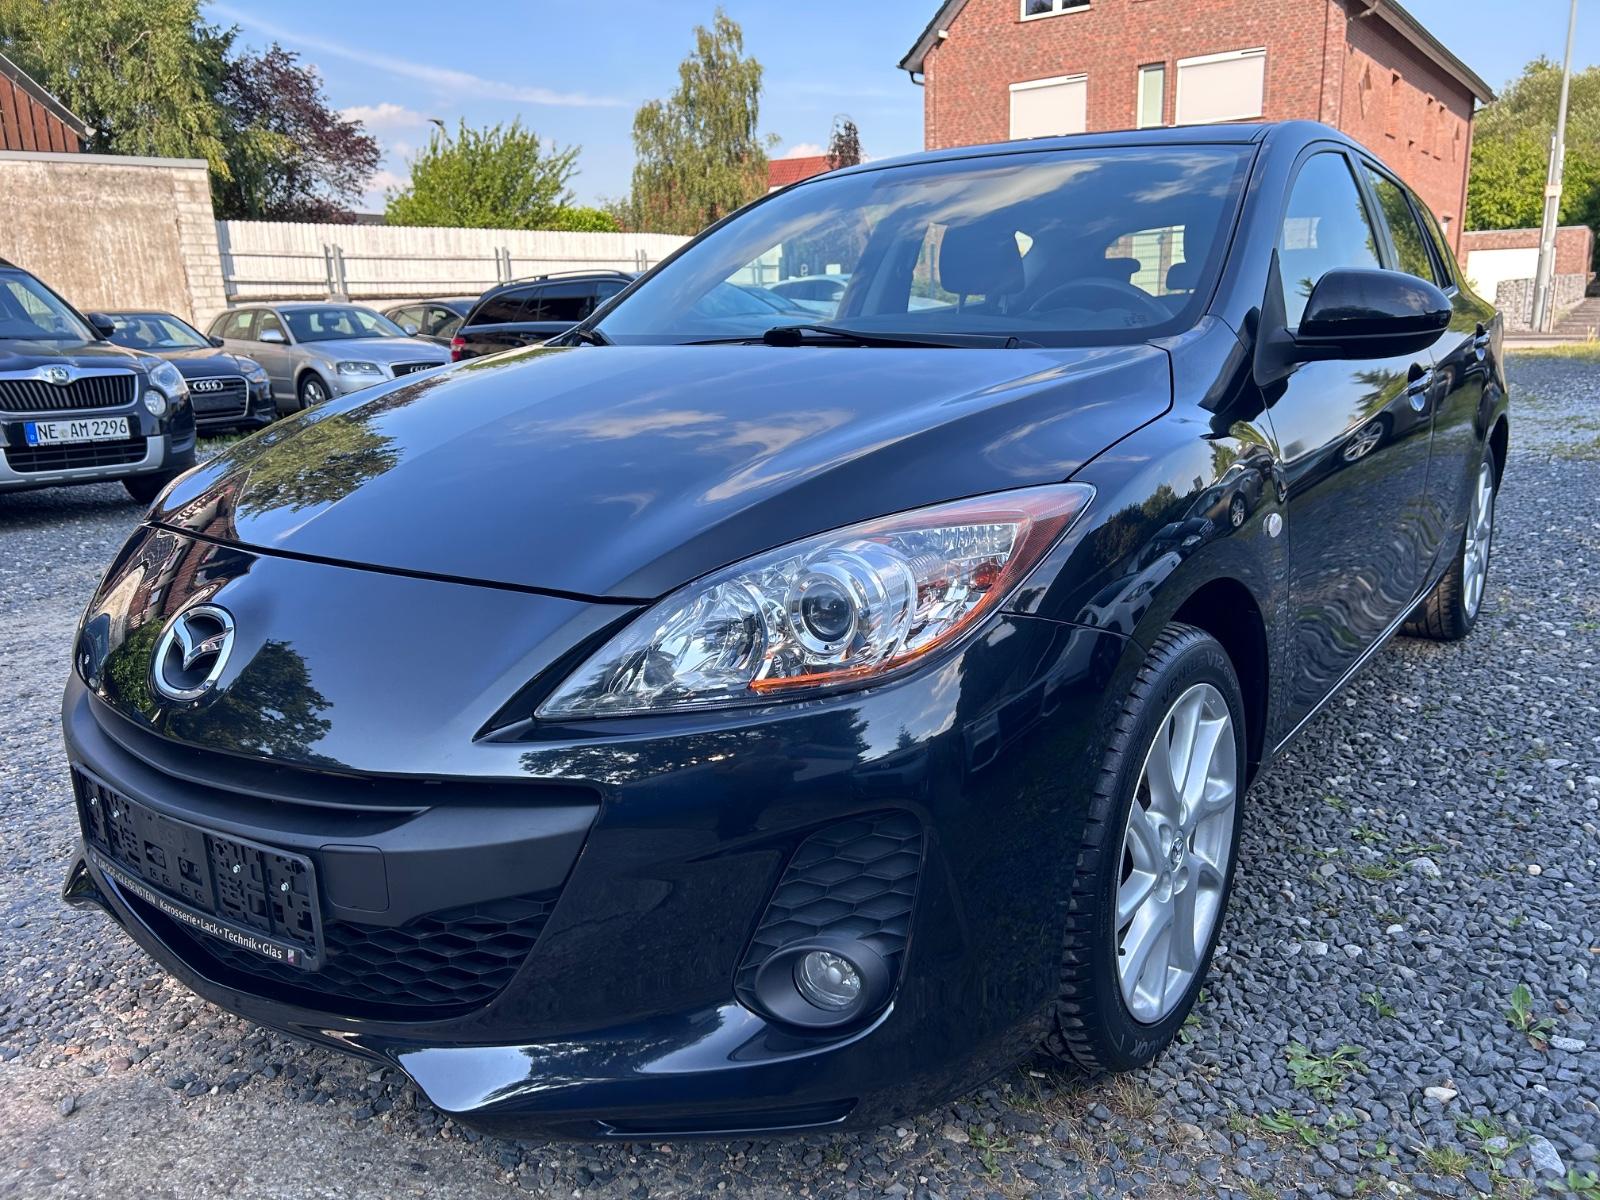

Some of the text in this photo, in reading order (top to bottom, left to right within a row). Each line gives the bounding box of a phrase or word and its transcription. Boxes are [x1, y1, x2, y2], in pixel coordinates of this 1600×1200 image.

[37, 419, 128, 440] NE AM 2296
[159, 899, 197, 925] Karosserie
[200, 918, 219, 935] Lack
[223, 927, 257, 950] Technik
[262, 943, 282, 959] Glas
